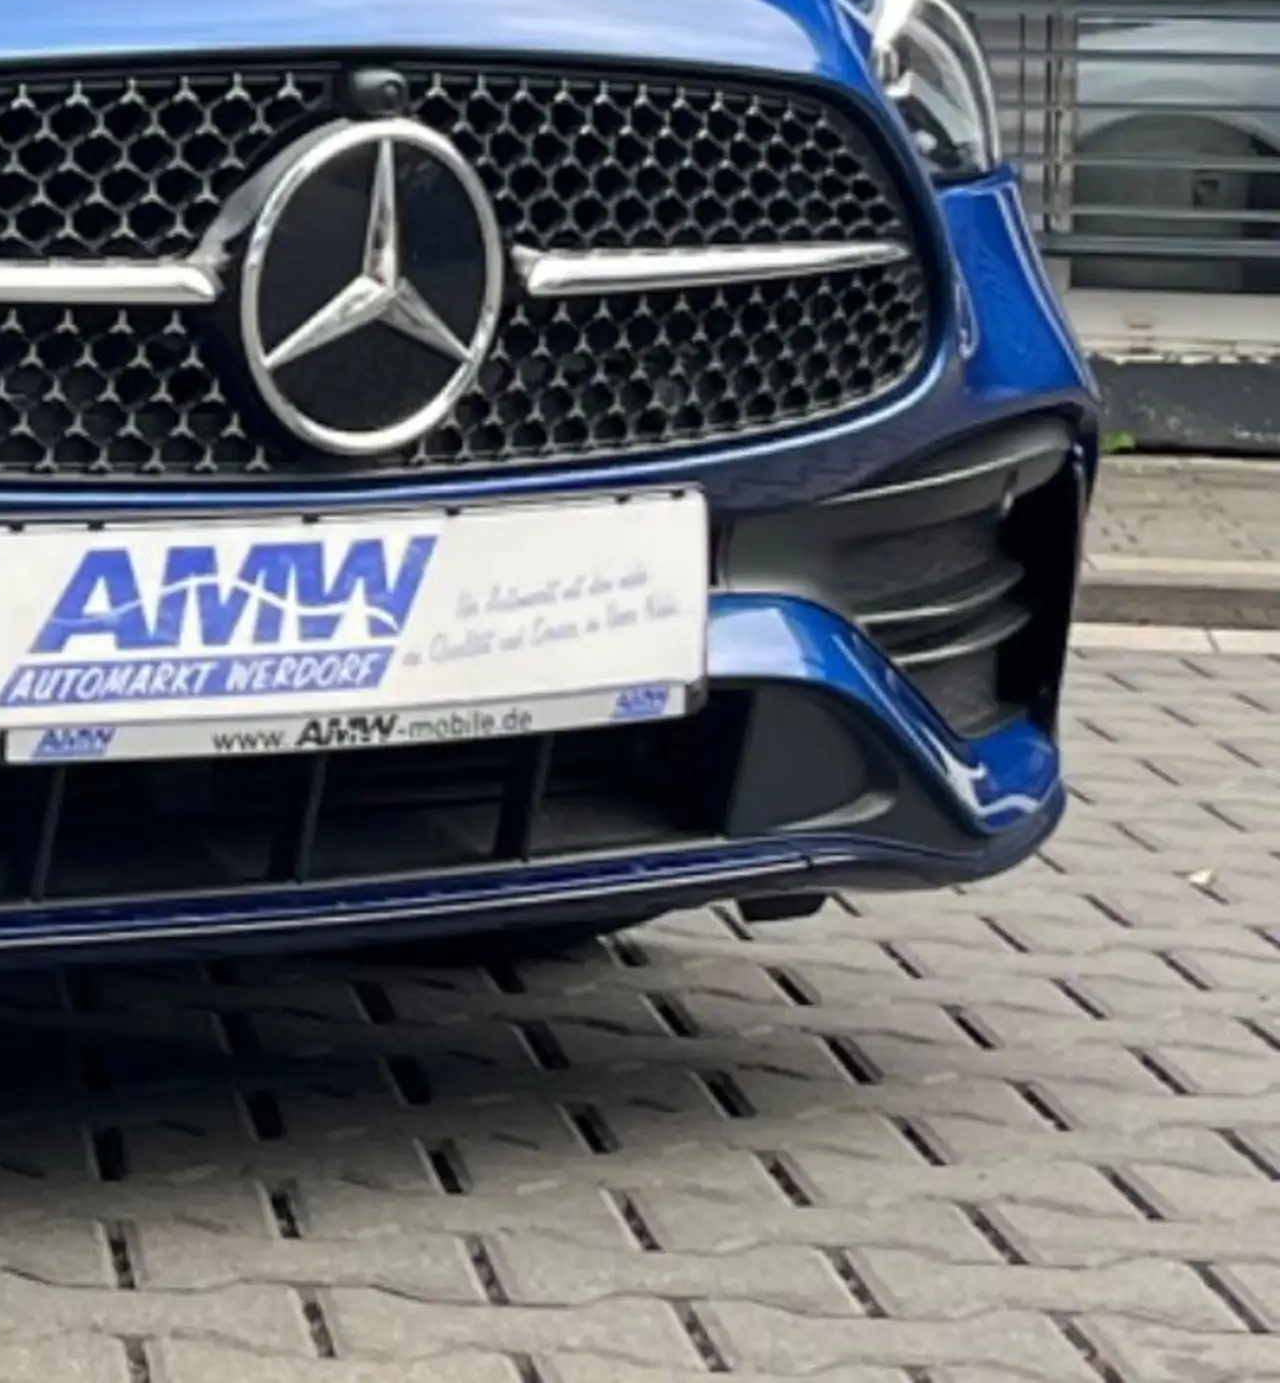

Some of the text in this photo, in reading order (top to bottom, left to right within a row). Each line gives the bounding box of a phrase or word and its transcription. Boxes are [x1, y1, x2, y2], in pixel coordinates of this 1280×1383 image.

[26, 534, 438, 654] AMW
[7, 651, 384, 703] AUTOMARKT WERDORF
